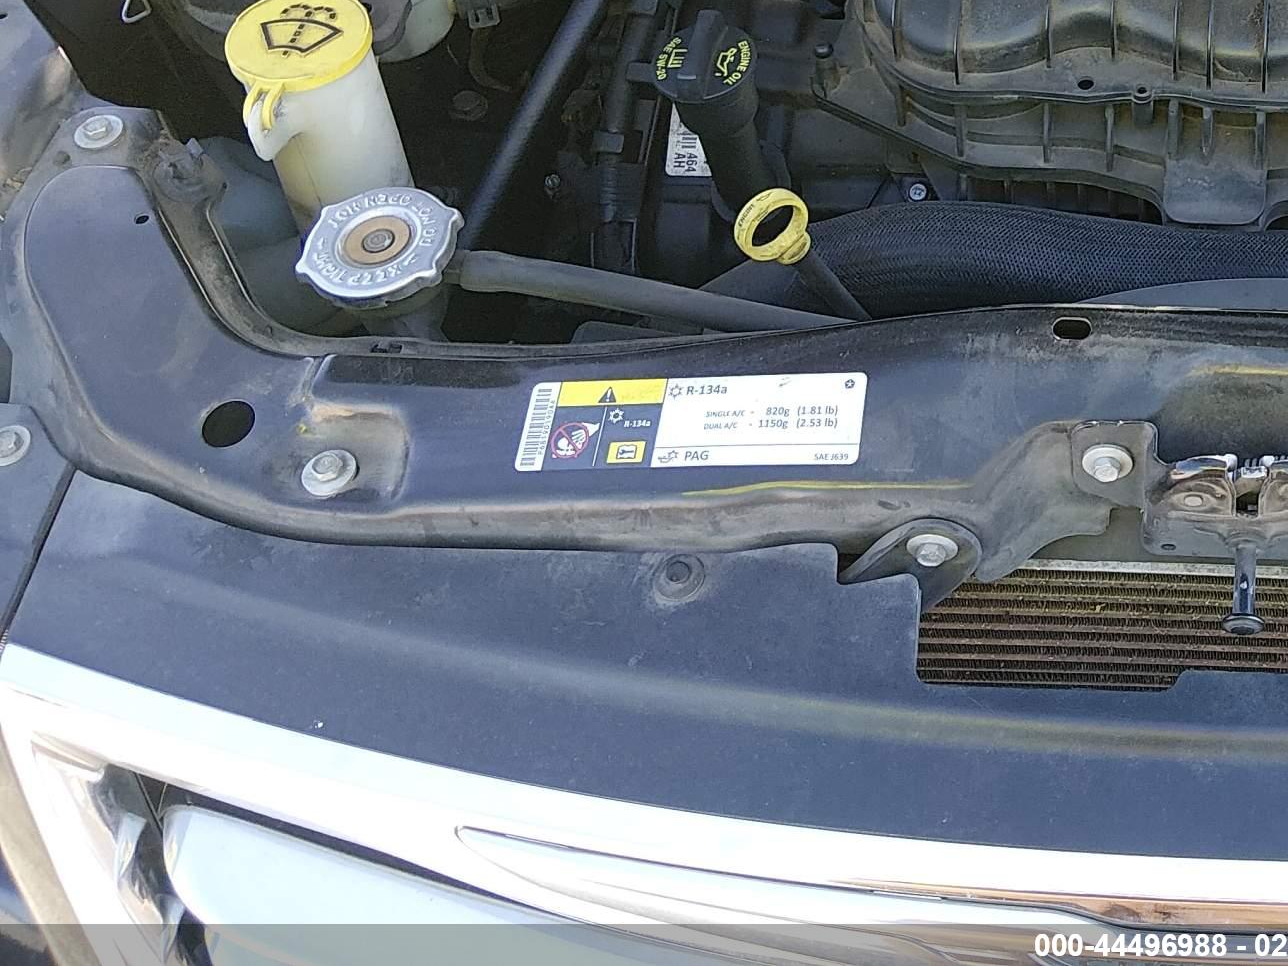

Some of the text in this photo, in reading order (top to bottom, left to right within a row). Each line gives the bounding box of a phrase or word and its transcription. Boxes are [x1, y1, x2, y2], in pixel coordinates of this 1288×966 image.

[655, 37, 682, 81] SAE 5W-20
[721, 40, 751, 86] ENGINE OIL
[686, 384, 728, 396] R-134a
[705, 410, 731, 418] SINGLE
[731, 409, 746, 417] A/C
[766, 406, 790, 417] 820g
[797, 406, 822, 417] (1.81
[824, 405, 839, 417] lb)
[623, 418, 651, 428] R-134a
[703, 422, 722, 430] DUAL
[722, 421, 738, 429] A/C
[758, 419, 789, 430] 1150g
[796, 418, 822, 429] (2.53
[824, 417, 838, 428] lb)
[684, 450, 849, 461] PAG SAE J639
